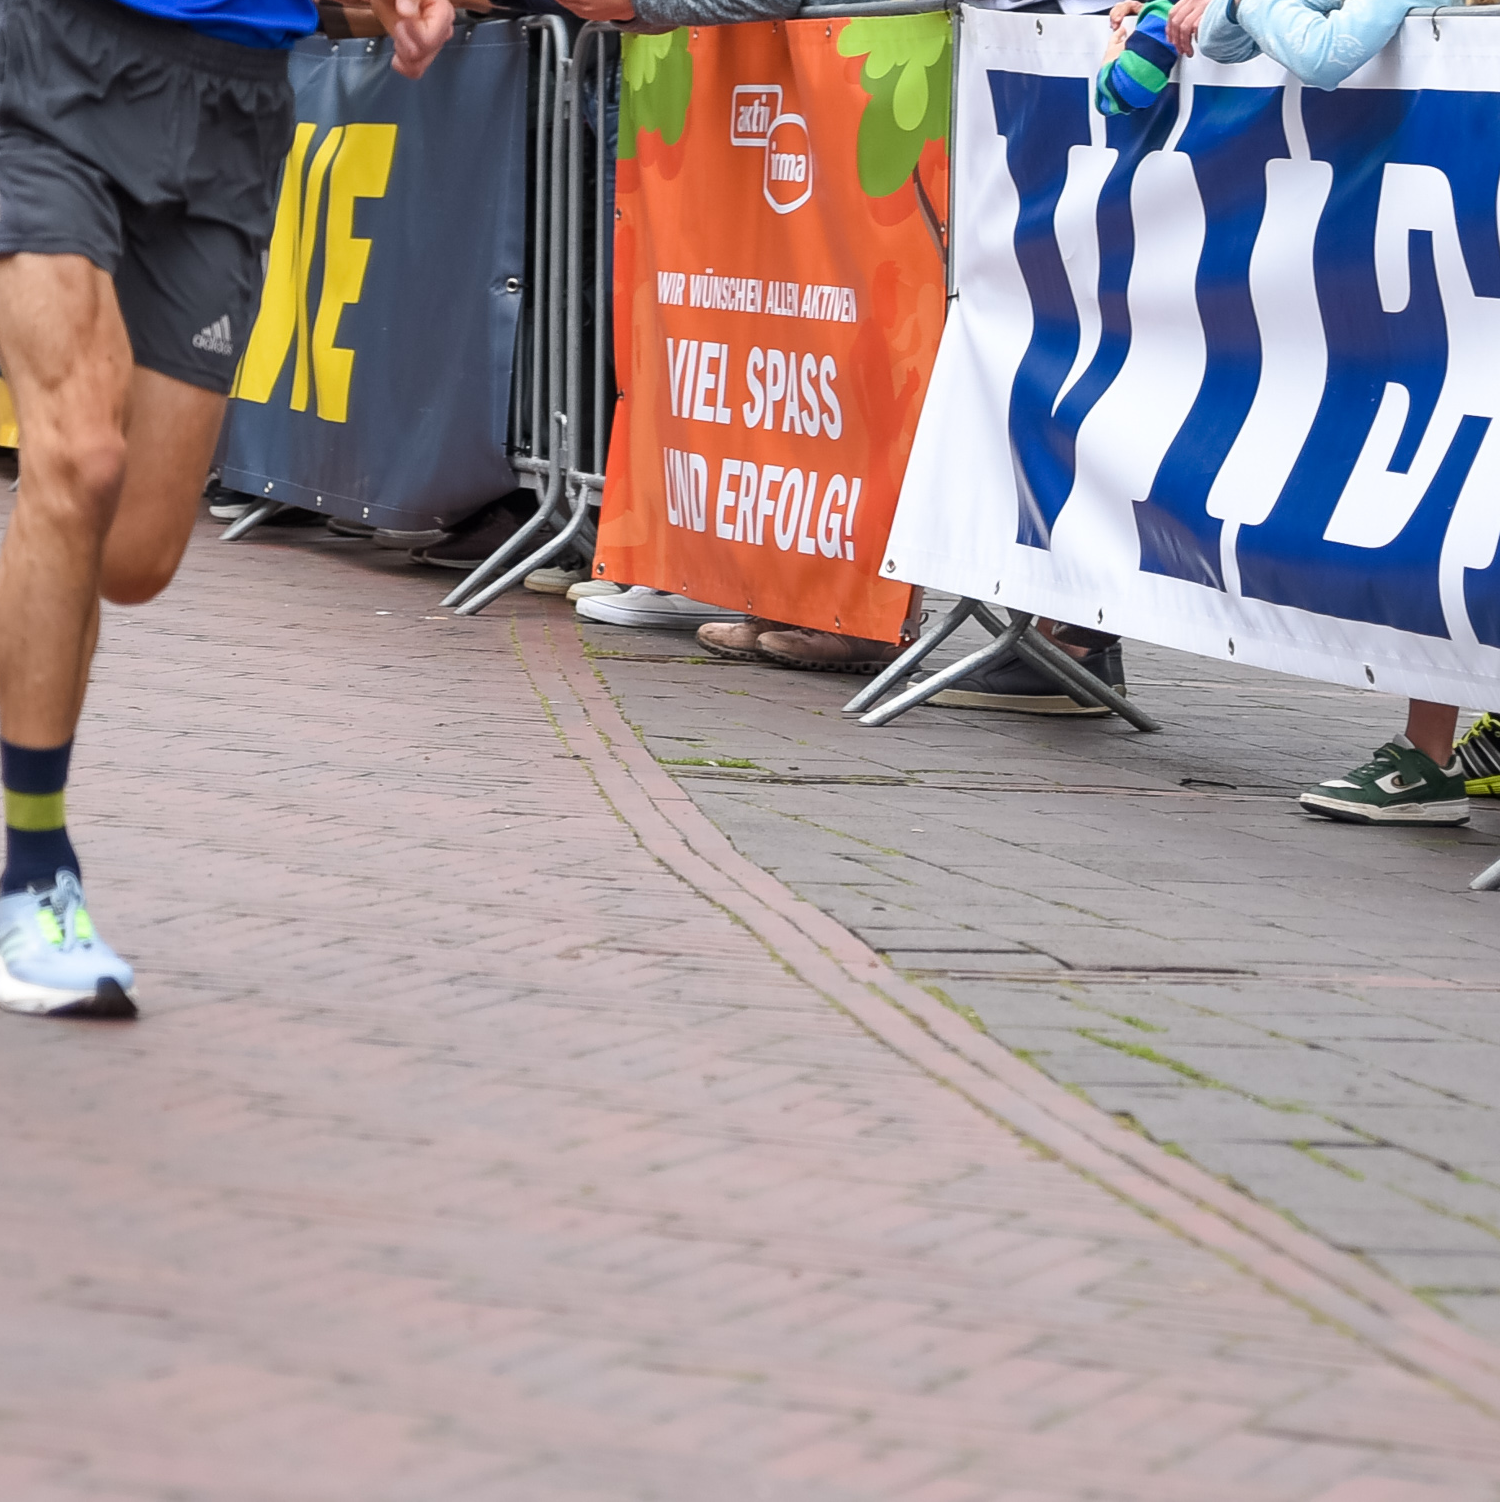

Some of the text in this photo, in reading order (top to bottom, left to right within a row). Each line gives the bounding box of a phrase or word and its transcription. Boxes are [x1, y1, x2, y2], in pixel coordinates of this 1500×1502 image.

[771, 141, 807, 183] irma
[657, 267, 857, 323] WIR WÜNSCHEN ALLEN AKTIVEN
[192, 334, 233, 357] adidas
[666, 337, 843, 441] VIEL SPASS
[663, 446, 862, 562] UND ERFOLG!
